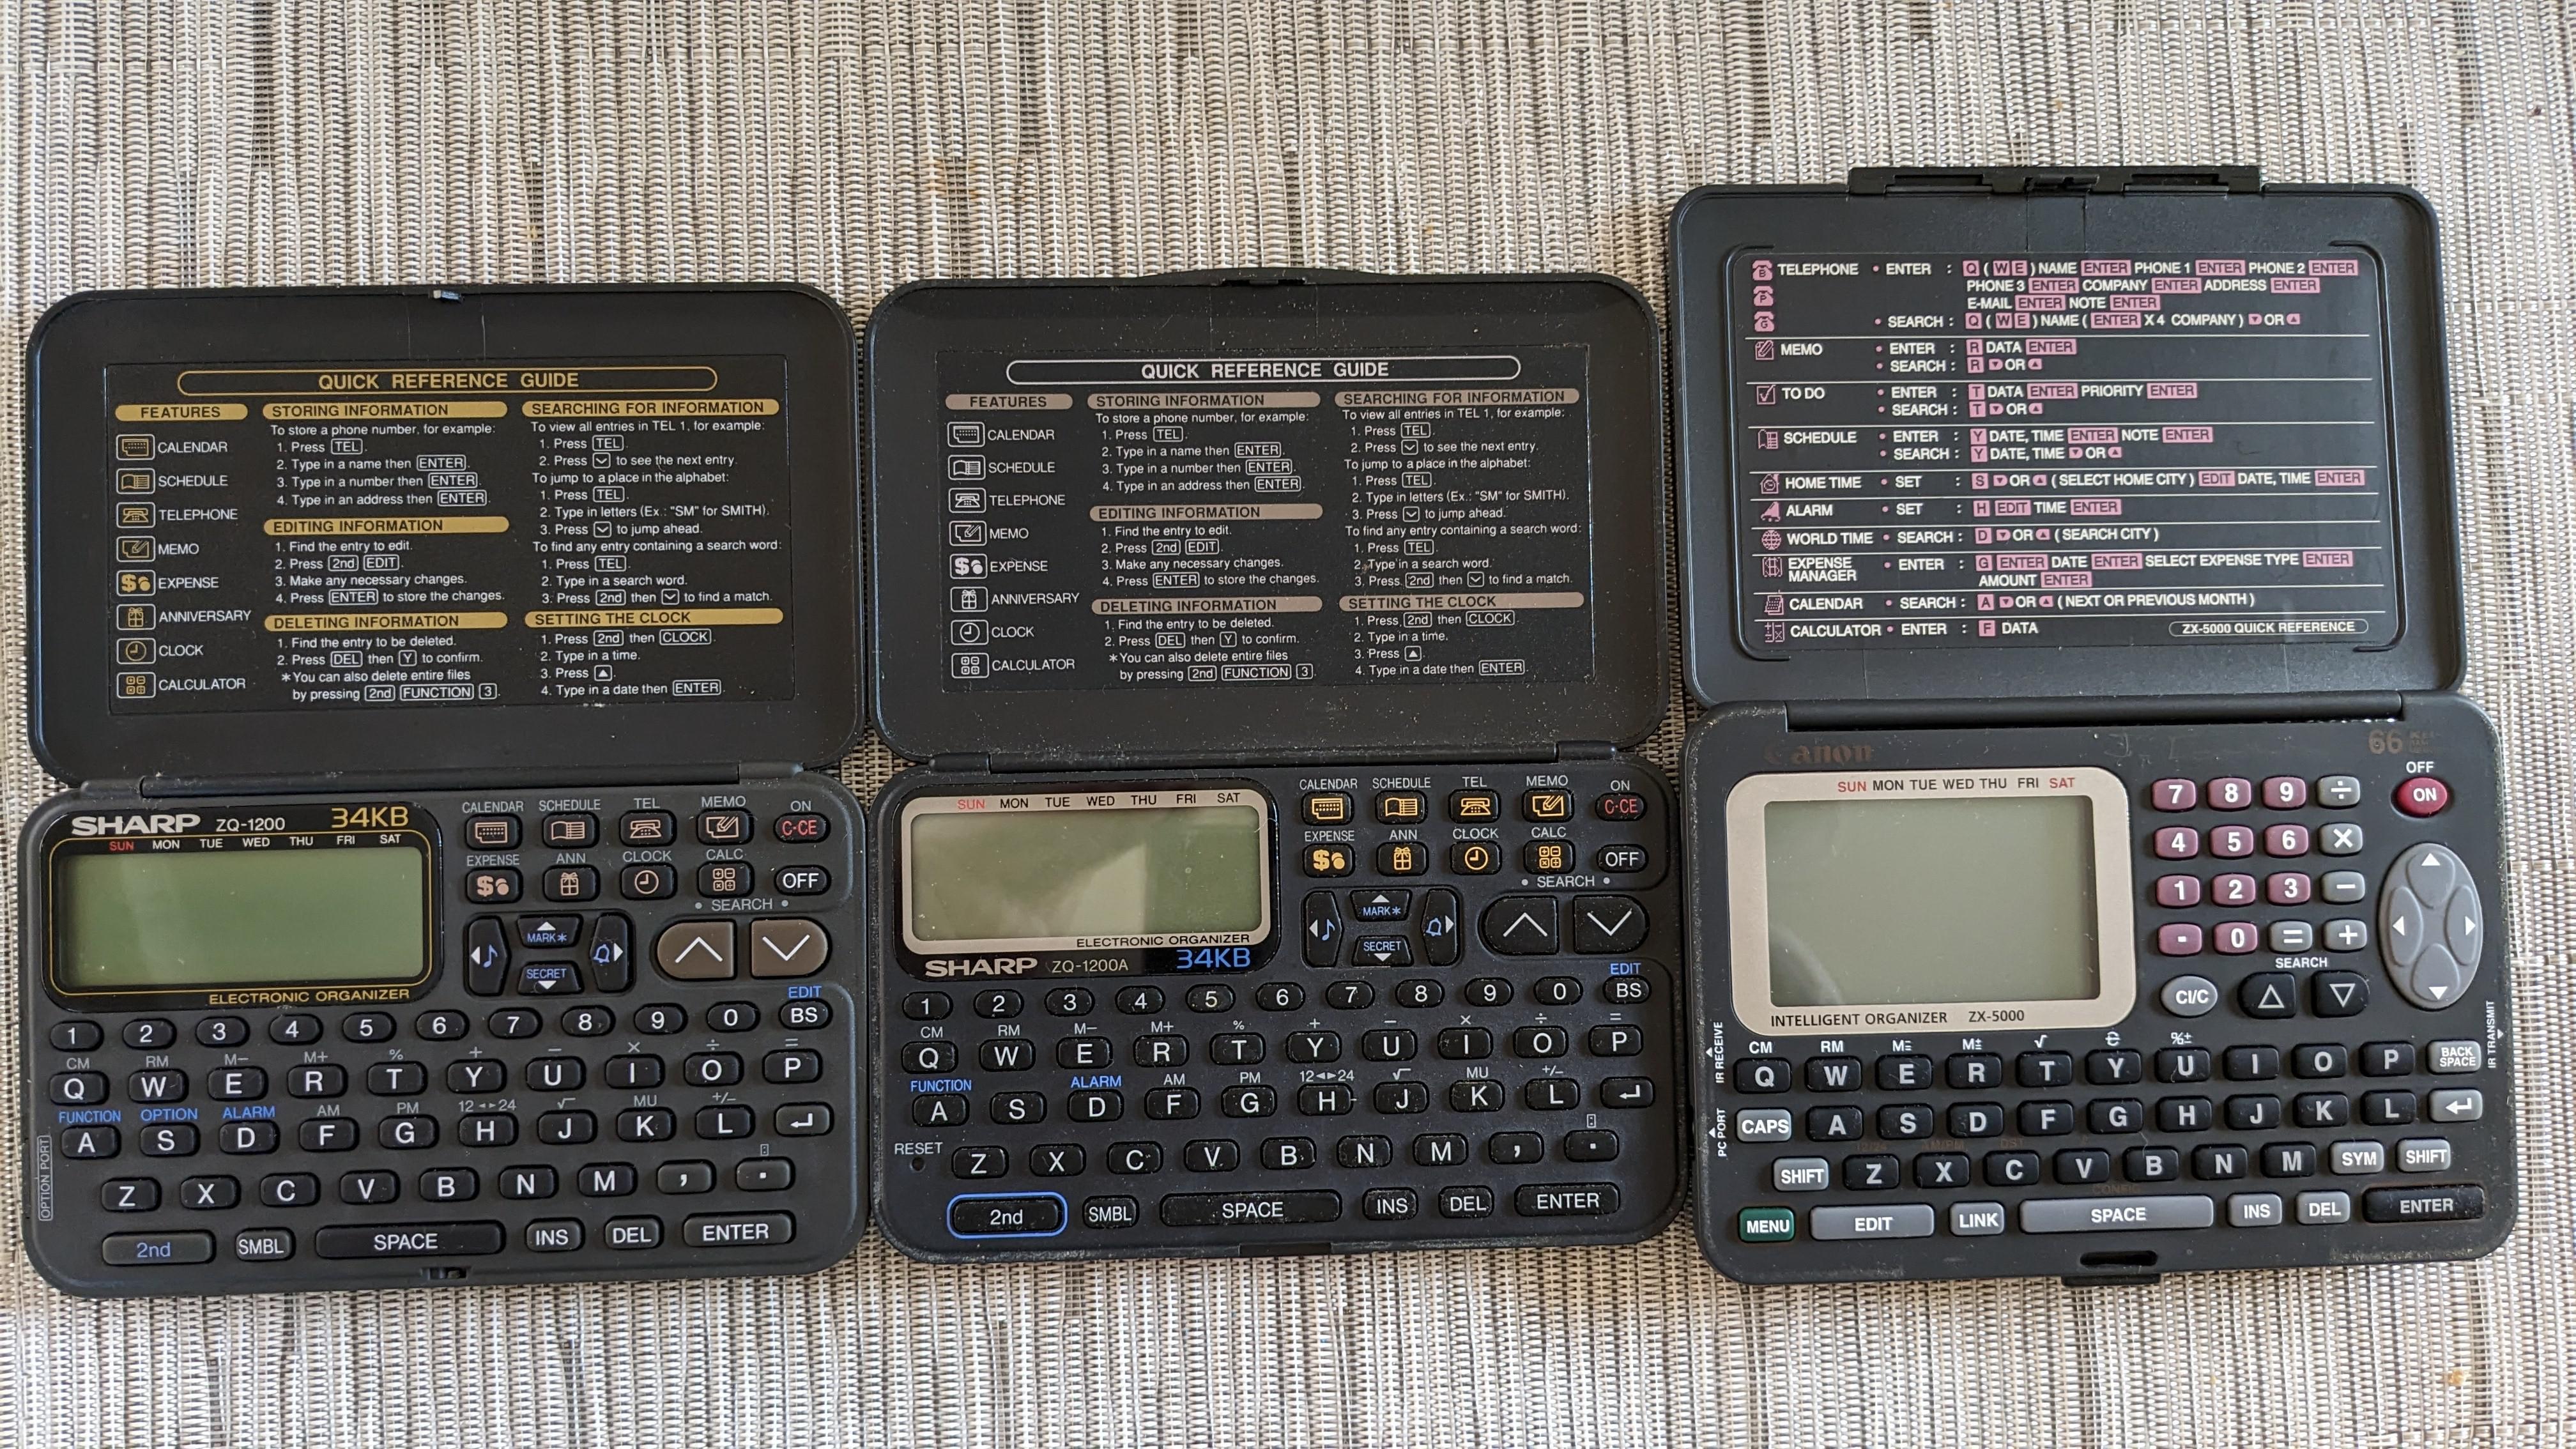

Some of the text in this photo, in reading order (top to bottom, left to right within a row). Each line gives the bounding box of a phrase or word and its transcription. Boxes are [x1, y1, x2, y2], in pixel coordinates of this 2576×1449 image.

[1778, 263, 2076, 275] TELEPHONE ENTER NAME
[2083, 280, 2266, 291] COMPANY ADDRESS
[1968, 297, 2106, 309] E-MAIL NOTE
[1781, 344, 1822, 355] MEMO
[1142, 363, 1389, 379] QUICK REFERENCE GUIDE
[319, 372, 579, 390] QUICK REFERENCE GUIDE
[1344, 391, 1564, 405] SEARCHING FOR INFORMATION
[1782, 388, 1825, 399] TO DO
[970, 396, 1047, 408] FEATURES
[1097, 395, 1264, 407] STORING INFORMATION
[141, 406, 220, 418] FEATURES
[272, 404, 448, 417] STORING INFORMATION
[532, 402, 764, 415] SEARCHING FOR INFORMATION
[271, 425, 285, 434] To
[288, 425, 317, 435] store
[332, 424, 368, 438] phone
[423, 424, 437, 434] for
[1784, 433, 1857, 443] SCHEDULE
[158, 442, 228, 454] CALENDAR
[1786, 477, 1862, 488] HOME TIME
[990, 494, 1066, 506] TELEPHONE
[159, 509, 238, 521] TELEPHONE
[555, 507, 584, 520] Type
[588, 507, 597, 516] in
[601, 506, 637, 517] letters
[703, 505, 717, 516] for
[1786, 505, 1832, 516] ALARM
[273, 519, 443, 532] EDITING INFORMATION
[990, 528, 1029, 539] MEMO
[1787, 533, 1873, 544] WORLD TIME
[158, 543, 199, 555] MEMO
[533, 542, 548, 552] To
[551, 541, 573, 551] find
[576, 542, 597, 554] any
[601, 542, 629, 553] entry
[634, 540, 693, 553] containing
[707, 540, 746, 551] search
[1789, 558, 1851, 569] EXPENSE
[2145, 554, 2349, 566] SELECT EXPENSE TYPE ENTER
[1789, 570, 1857, 581] MANAGER
[992, 593, 1079, 604] ANNIVERSARY
[1790, 599, 1863, 610] CALENDAR
[2066, 594, 2246, 606] NEXT OR PREVIOUS MONTH
[159, 611, 251, 622] ANNIVERSARY
[274, 615, 459, 629] DELETING INFORMATION
[535, 612, 691, 625] SETTING THE CLOCK
[1790, 625, 1881, 636] CALCULATOR
[2183, 622, 2355, 634] ZX-5000 QUICK REFERENCE
[992, 659, 1075, 670] CALCULATOR
[158, 678, 245, 690] CALCULATOR
[2406, 761, 2434, 773] OFF
[1837, 777, 2075, 792] SUN MON TUE WED THU FRI SAT
[2413, 788, 2436, 801] ON
[462, 801, 523, 813] CALENDAR
[539, 799, 601, 811] SCHEDULE
[702, 795, 746, 808] MEMO
[72, 807, 409, 836] SHARP ZQ-1200 34KB
[109, 834, 401, 851] SUN MON TUE WED THU FRI SAT
[556, 852, 586, 864] ANN
[783, 874, 819, 888] OFF
[1537, 875, 1595, 887] SEARCH
[712, 898, 772, 911] SEARCH
[1077, 934, 1250, 947] ELECTRONIC ORGANIZER
[925, 948, 1251, 976] SHARP ZQ-1200A 34KB
[2276, 957, 2327, 968] SEARCH
[526, 969, 566, 979] SECRET
[210, 989, 409, 1004] ELECTRONIC ORGANIZER
[1771, 1009, 2025, 1027] INTELLIGENT ORGANIZER ZX-5000
[2487, 1000, 2496, 1068] IR TRANSMIT
[1713, 1022, 1724, 1083] IR RECEIVE
[2441, 1047, 2473, 1057] BACK
[2440, 1056, 2476, 1068] SPACE
[910, 1079, 971, 1092] FUNCTION
[59, 1111, 121, 1123] FUNCTION
[141, 1108, 198, 1121] OPTION
[223, 1107, 275, 1119] ALARM
[1717, 1108, 1726, 1157] PC PORT
[1742, 1119, 1789, 1134] CAPS
[895, 1142, 942, 1154] RESET
[2342, 1152, 2377, 1167] SYM
[2406, 1149, 2447, 1164] SHIFT
[40, 1138, 50, 1218] OPTION PORT
[1747, 1219, 1790, 1234] MENU
[1959, 1213, 1998, 1229] LINK
[703, 1225, 769, 1241] ENTER
[374, 1234, 438, 1250] SPACE
[137, 1243, 171, 1258] 2nd
